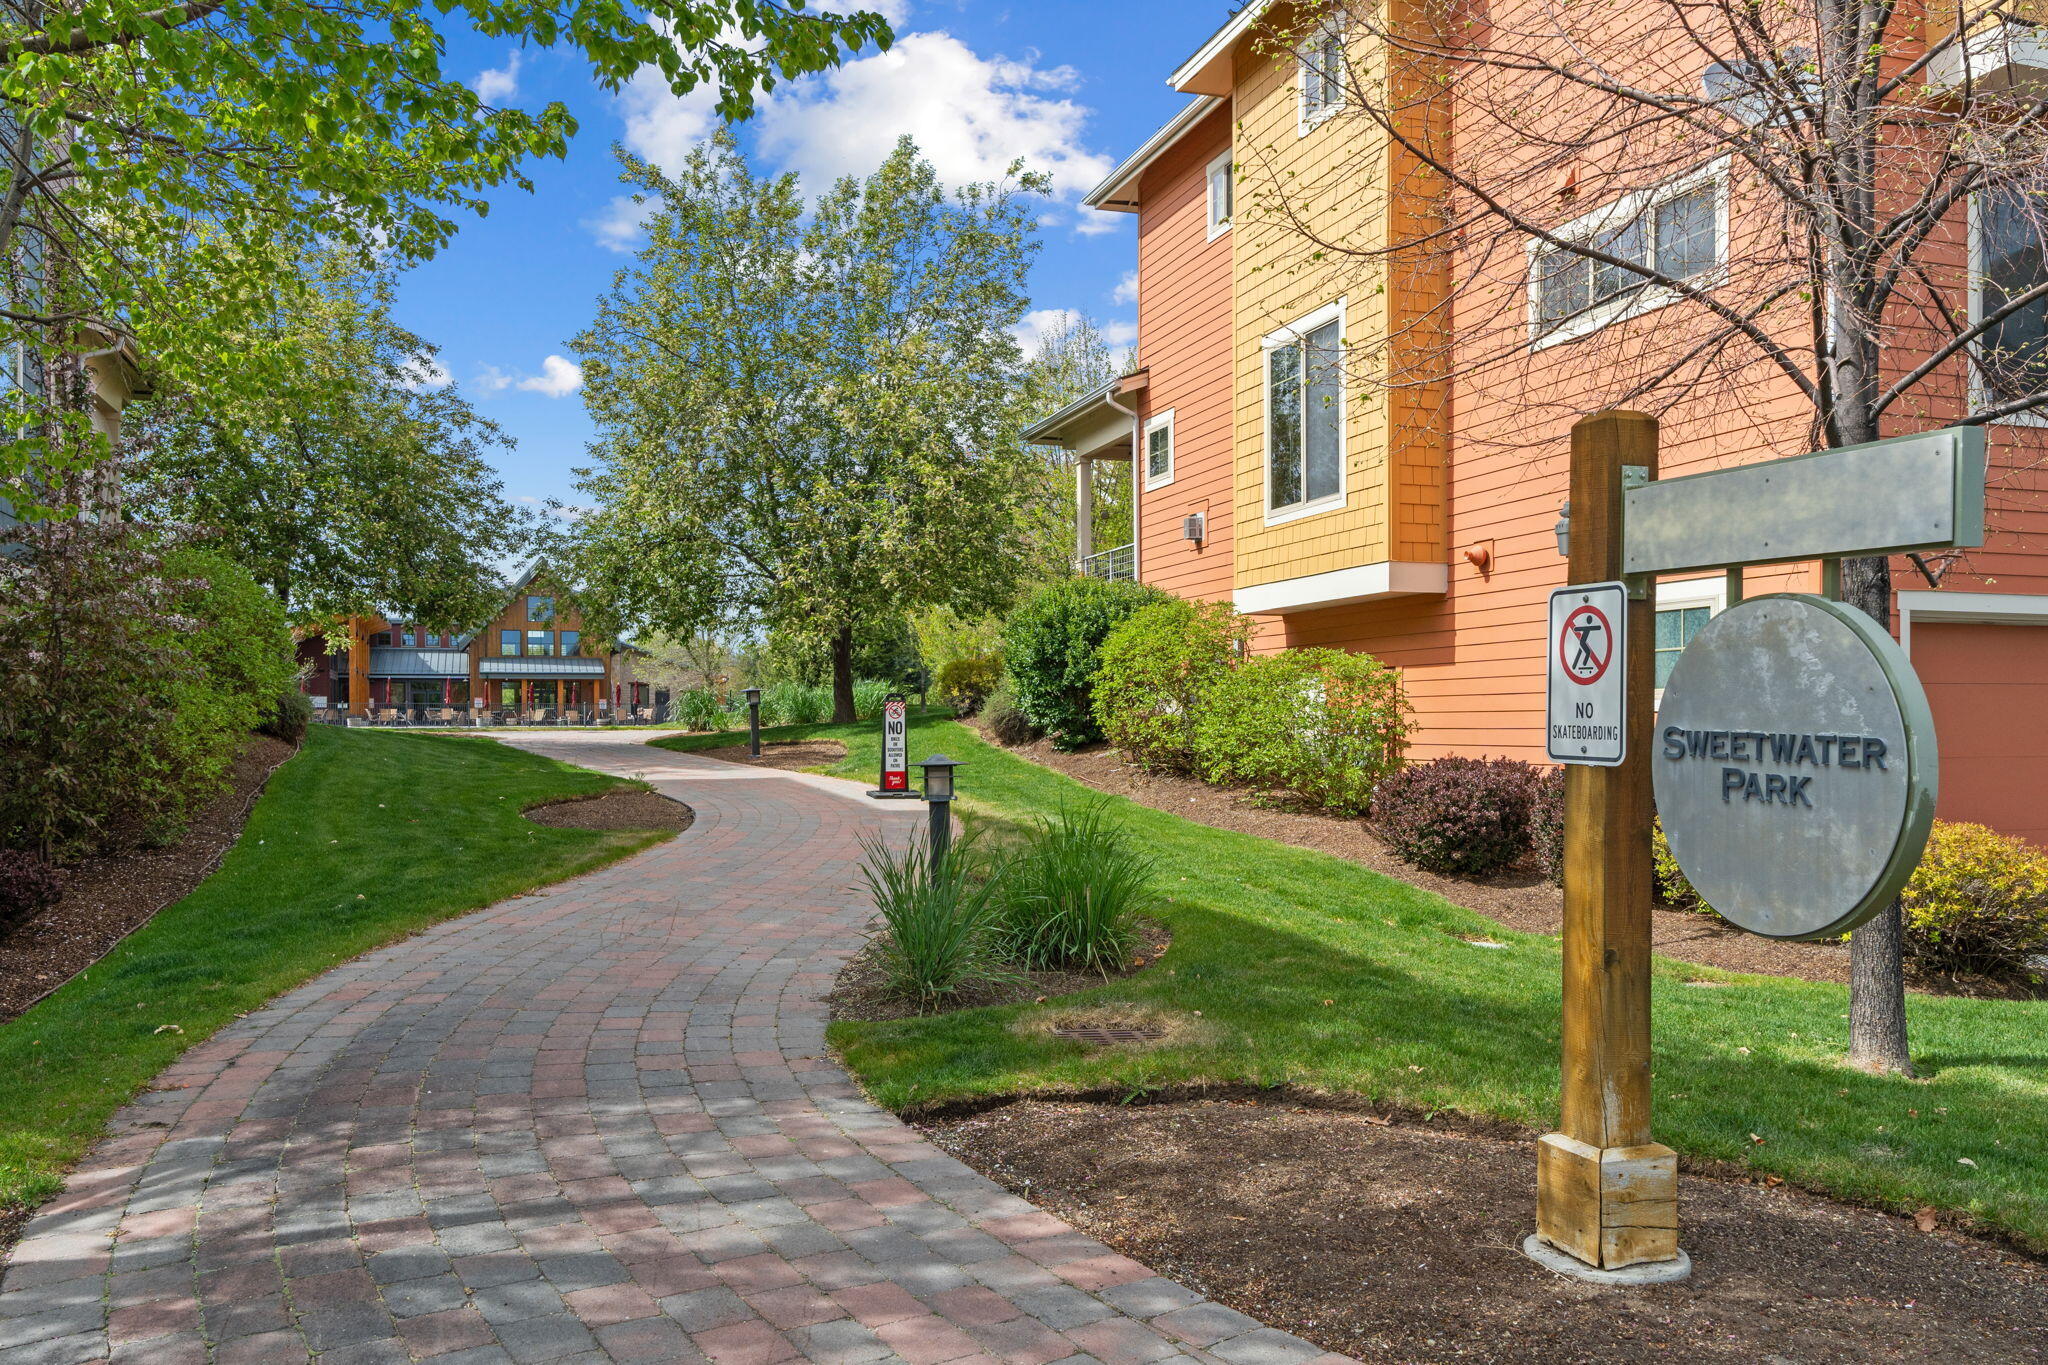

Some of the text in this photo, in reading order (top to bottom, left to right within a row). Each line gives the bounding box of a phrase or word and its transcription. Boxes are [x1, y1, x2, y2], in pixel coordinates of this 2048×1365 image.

[1575, 702, 1594, 719] NO
[888, 721, 903, 735] NO
[1552, 724, 1618, 741] SKATEBOARDING
[1662, 725, 1889, 770] SWEETWATER
[1721, 766, 1813, 807] PARK
